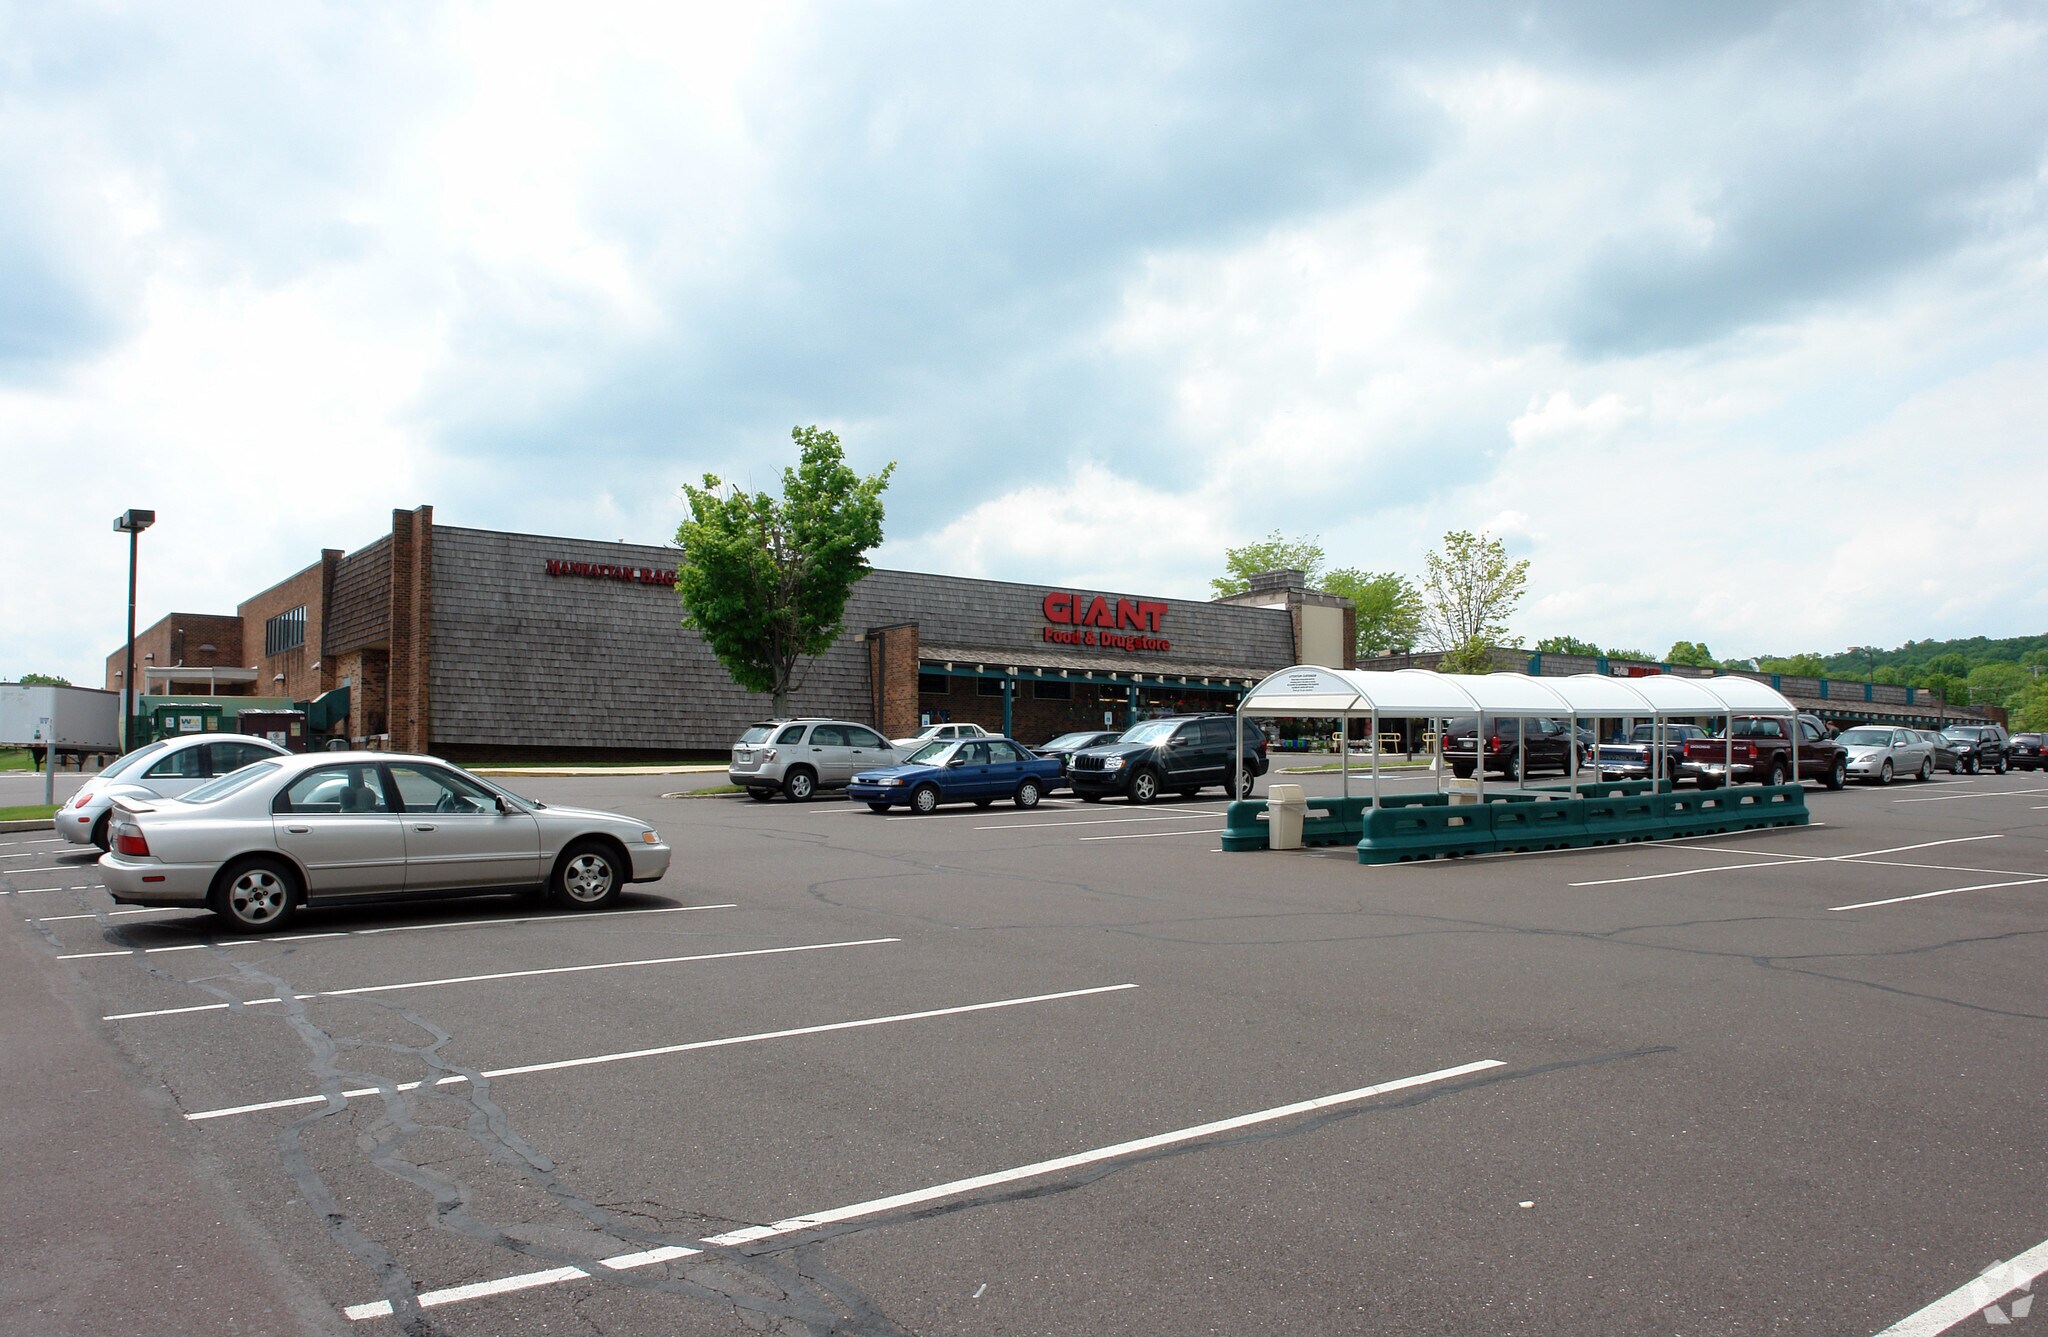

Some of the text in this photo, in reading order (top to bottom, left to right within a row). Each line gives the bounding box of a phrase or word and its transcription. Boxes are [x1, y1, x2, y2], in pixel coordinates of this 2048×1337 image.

[547, 559, 684, 586] MANHATTAN BAG
[1043, 591, 1169, 632] GIANT
[1044, 627, 1171, 651] Food & Drugstore
